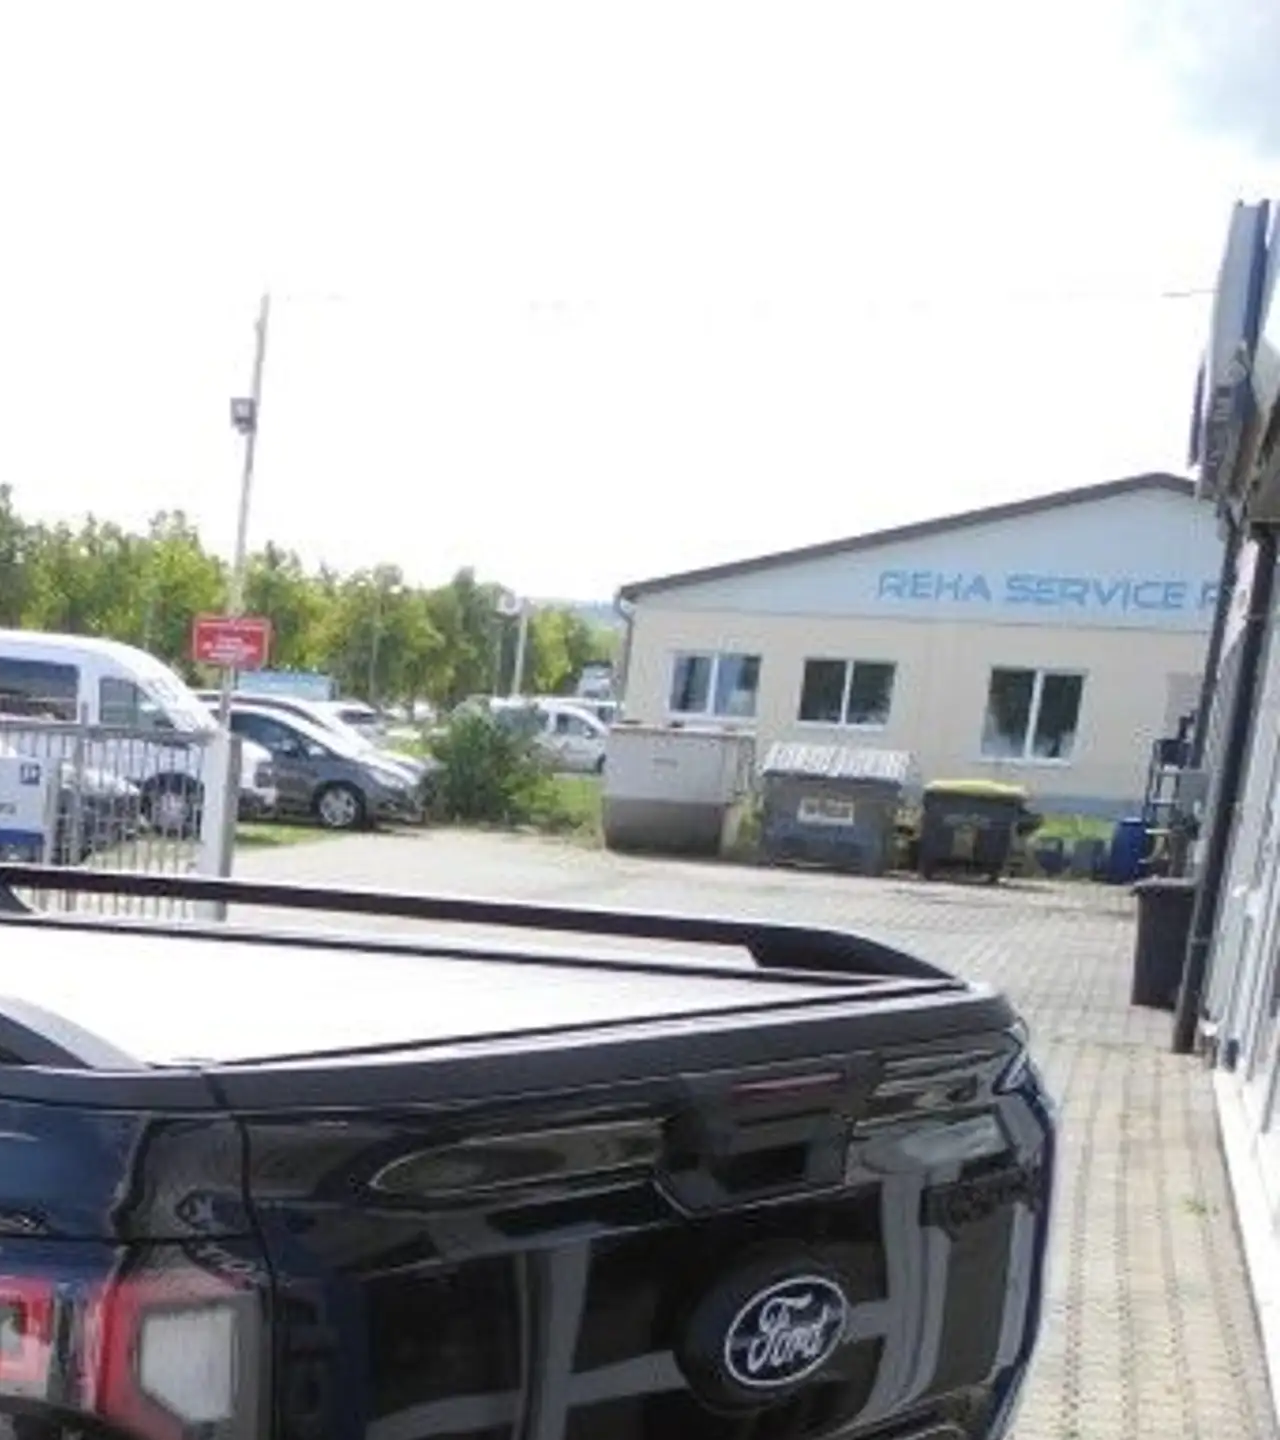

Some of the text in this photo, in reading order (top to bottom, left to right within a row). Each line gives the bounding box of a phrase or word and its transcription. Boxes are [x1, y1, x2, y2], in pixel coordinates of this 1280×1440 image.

[877, 568, 991, 604] REHA
[1003, 571, 1188, 612] SERVICE
[745, 1292, 828, 1373] Ford
